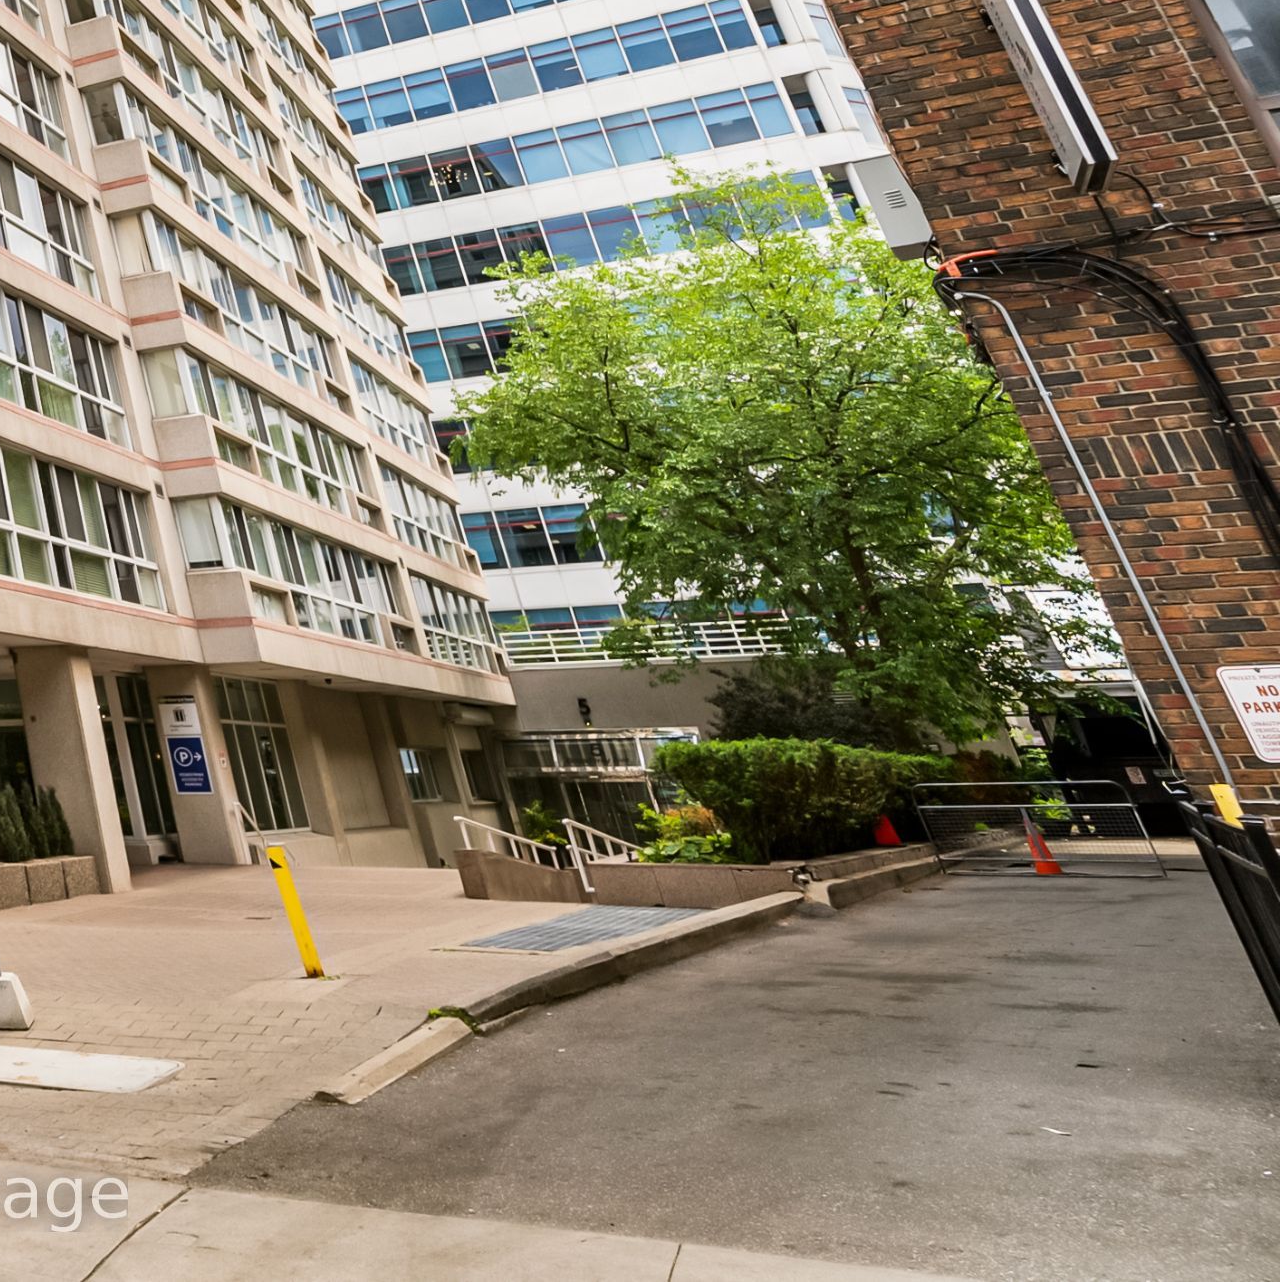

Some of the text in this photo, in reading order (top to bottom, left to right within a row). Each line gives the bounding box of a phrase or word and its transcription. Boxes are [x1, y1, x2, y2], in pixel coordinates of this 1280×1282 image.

[1256, 685, 1279, 696] NO
[577, 698, 591, 715] 5
[180, 752, 188, 762] P
